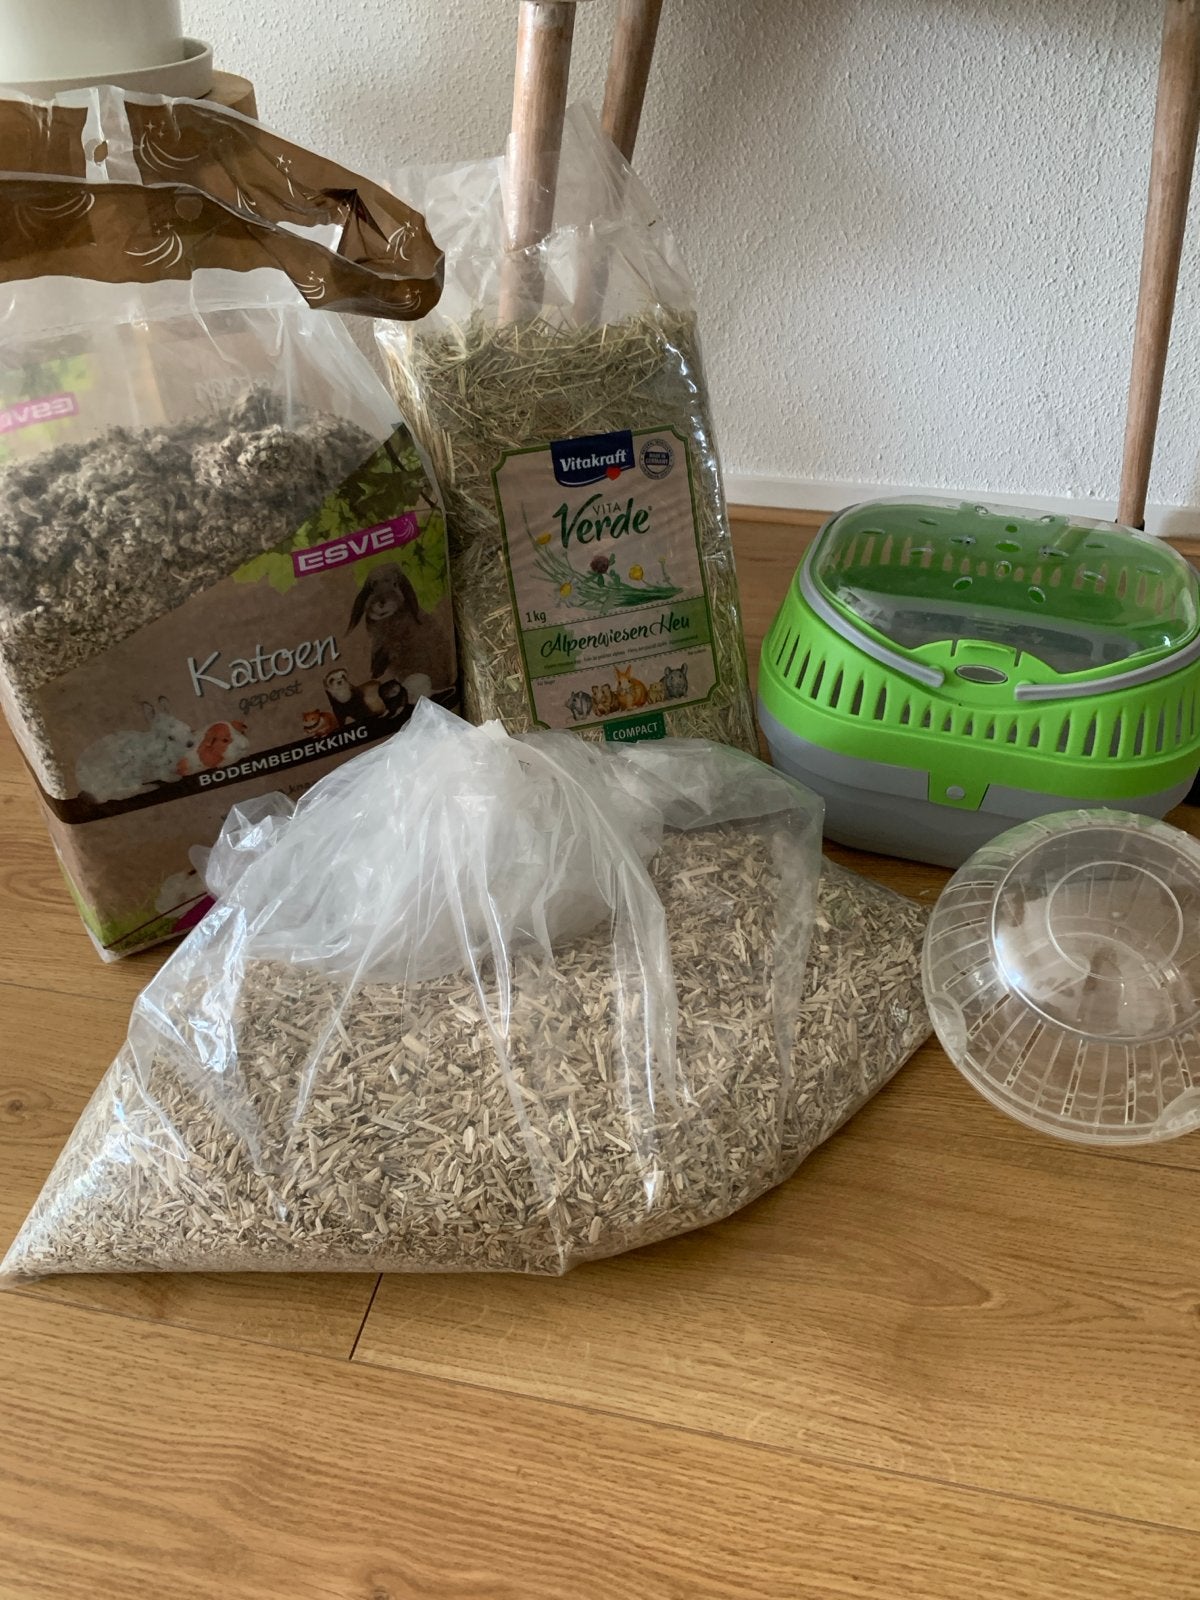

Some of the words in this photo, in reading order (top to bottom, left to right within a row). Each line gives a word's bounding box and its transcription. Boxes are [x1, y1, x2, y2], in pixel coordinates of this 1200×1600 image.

[560, 448, 627, 472] Vitakraft
[552, 493, 650, 549] Verde
[592, 502, 622, 515] VITA
[298, 526, 395, 572] ESVE
[525, 611, 532, 623] 1
[533, 610, 547, 623] kg
[540, 625, 649, 658] Alpenwiesen
[649, 611, 690, 636] Heu
[187, 635, 341, 697] Katoen
[238, 680, 304, 715] geperst
[612, 721, 658, 741] COMPACT
[199, 725, 369, 787] BODEMBEDEKKING
